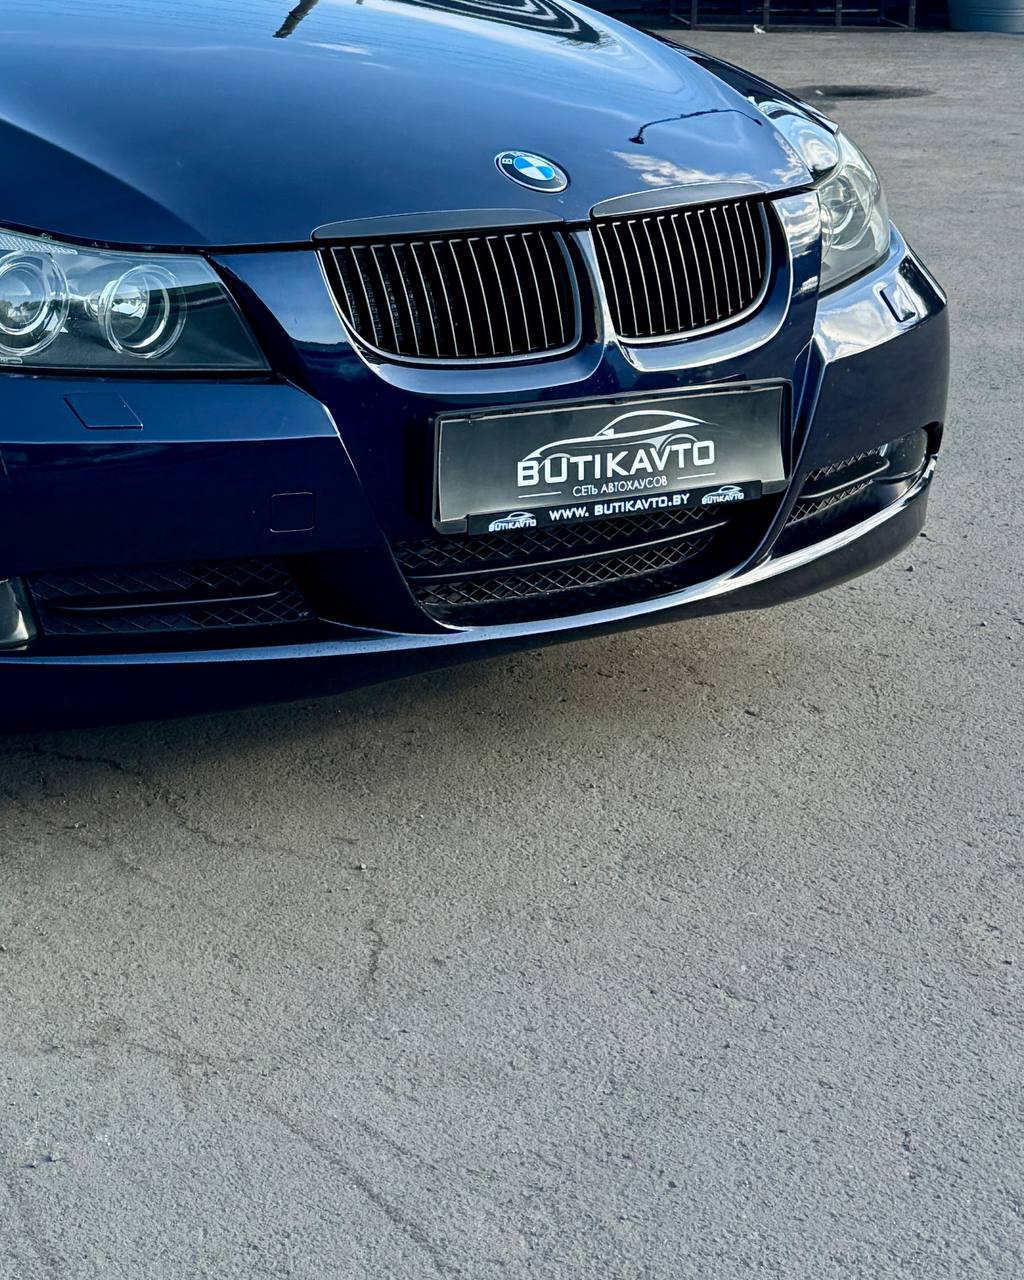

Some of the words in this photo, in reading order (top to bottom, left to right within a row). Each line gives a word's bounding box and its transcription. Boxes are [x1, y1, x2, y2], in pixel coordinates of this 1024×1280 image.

[517, 440, 715, 487] BUTIKAVTO
[572, 484, 598, 497] СЕТЬ
[600, 475, 668, 495] АВТОХАУСОВ
[594, 493, 690, 516] BUTIKAVTO.BY
[701, 492, 744, 505] BUTIKAVTO
[488, 519, 536, 532] BUTIKAVTO
